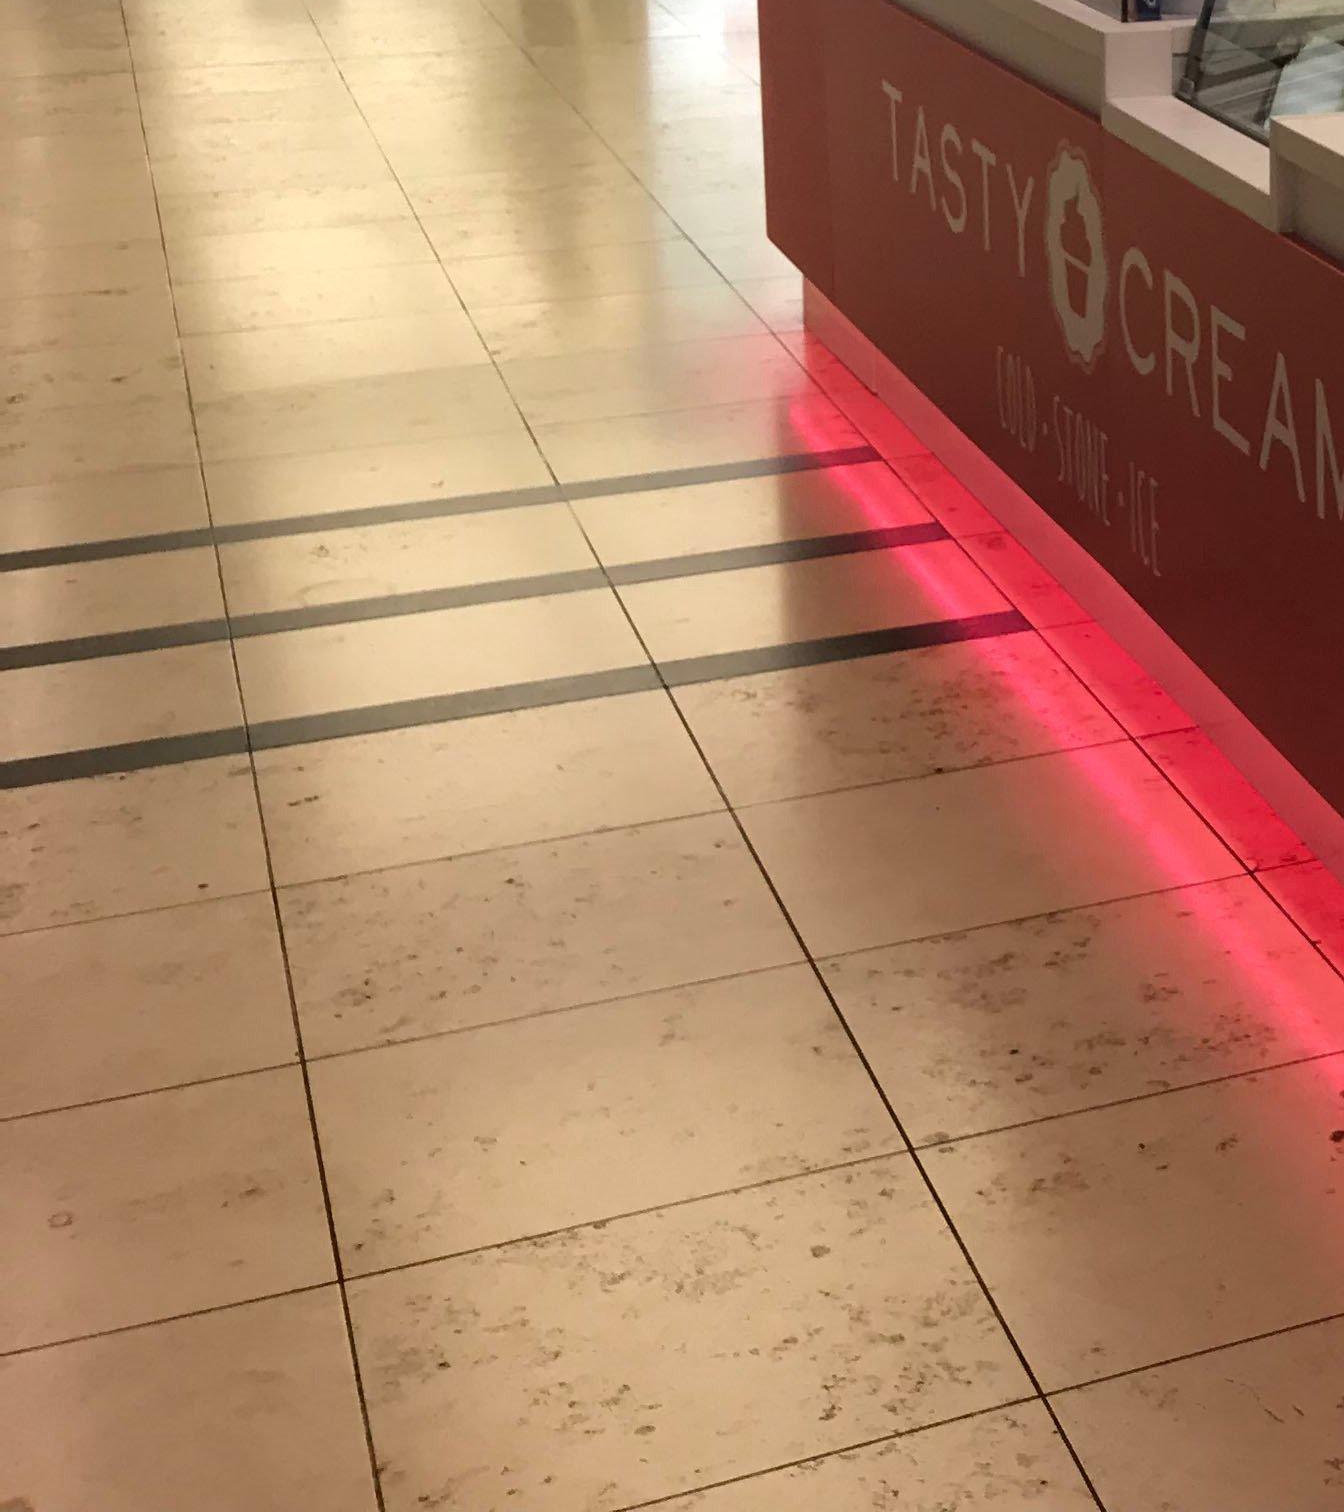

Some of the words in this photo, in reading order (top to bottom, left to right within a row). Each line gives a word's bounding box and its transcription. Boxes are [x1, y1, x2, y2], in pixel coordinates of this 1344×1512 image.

[880, 78, 1035, 278] TASTY
[995, 345, 1038, 453] COLD
[1052, 394, 1112, 528] STONE
[1128, 460, 1162, 578] ICE
